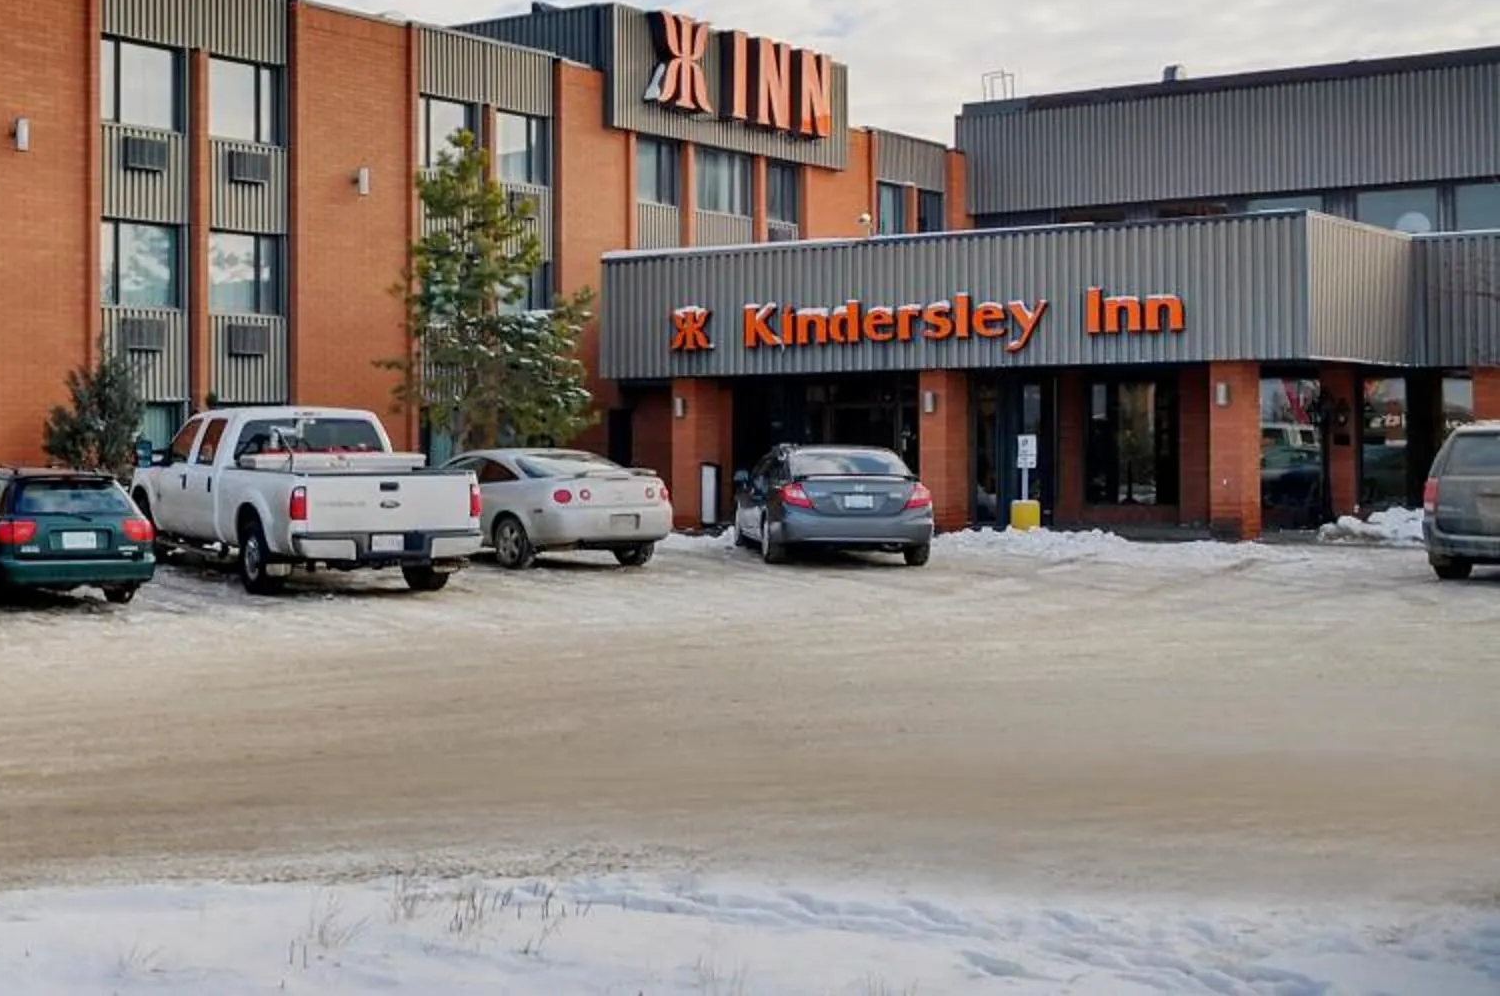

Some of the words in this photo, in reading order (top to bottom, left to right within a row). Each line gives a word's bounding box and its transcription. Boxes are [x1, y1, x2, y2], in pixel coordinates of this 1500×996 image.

[720, 29, 831, 138] INN
[743, 292, 1048, 352] Kindersley
[1086, 286, 1185, 334] Inn
